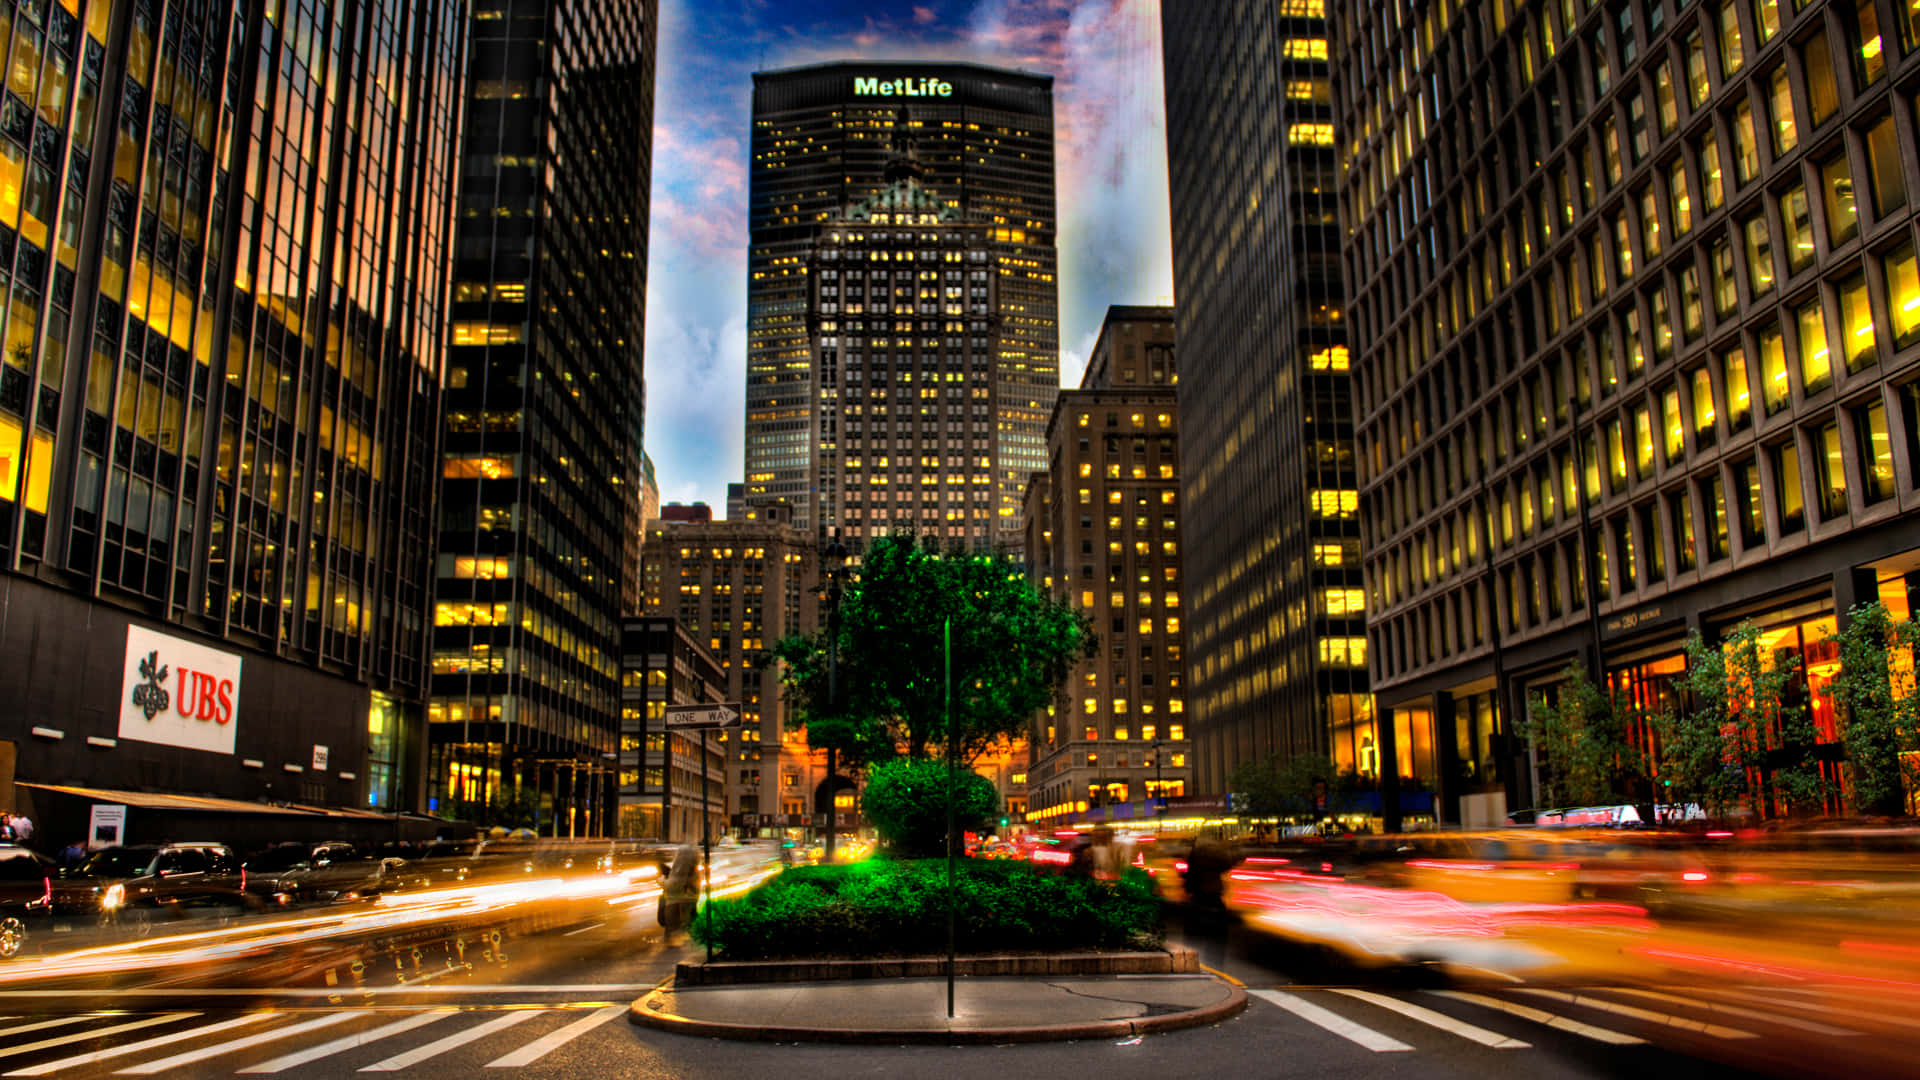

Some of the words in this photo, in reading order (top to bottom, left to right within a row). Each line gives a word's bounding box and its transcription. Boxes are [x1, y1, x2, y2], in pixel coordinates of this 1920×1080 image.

[854, 77, 953, 96] MetLife
[176, 667, 233, 725] UBS
[674, 712, 696, 722] ONE
[708, 711, 730, 721] WAY
